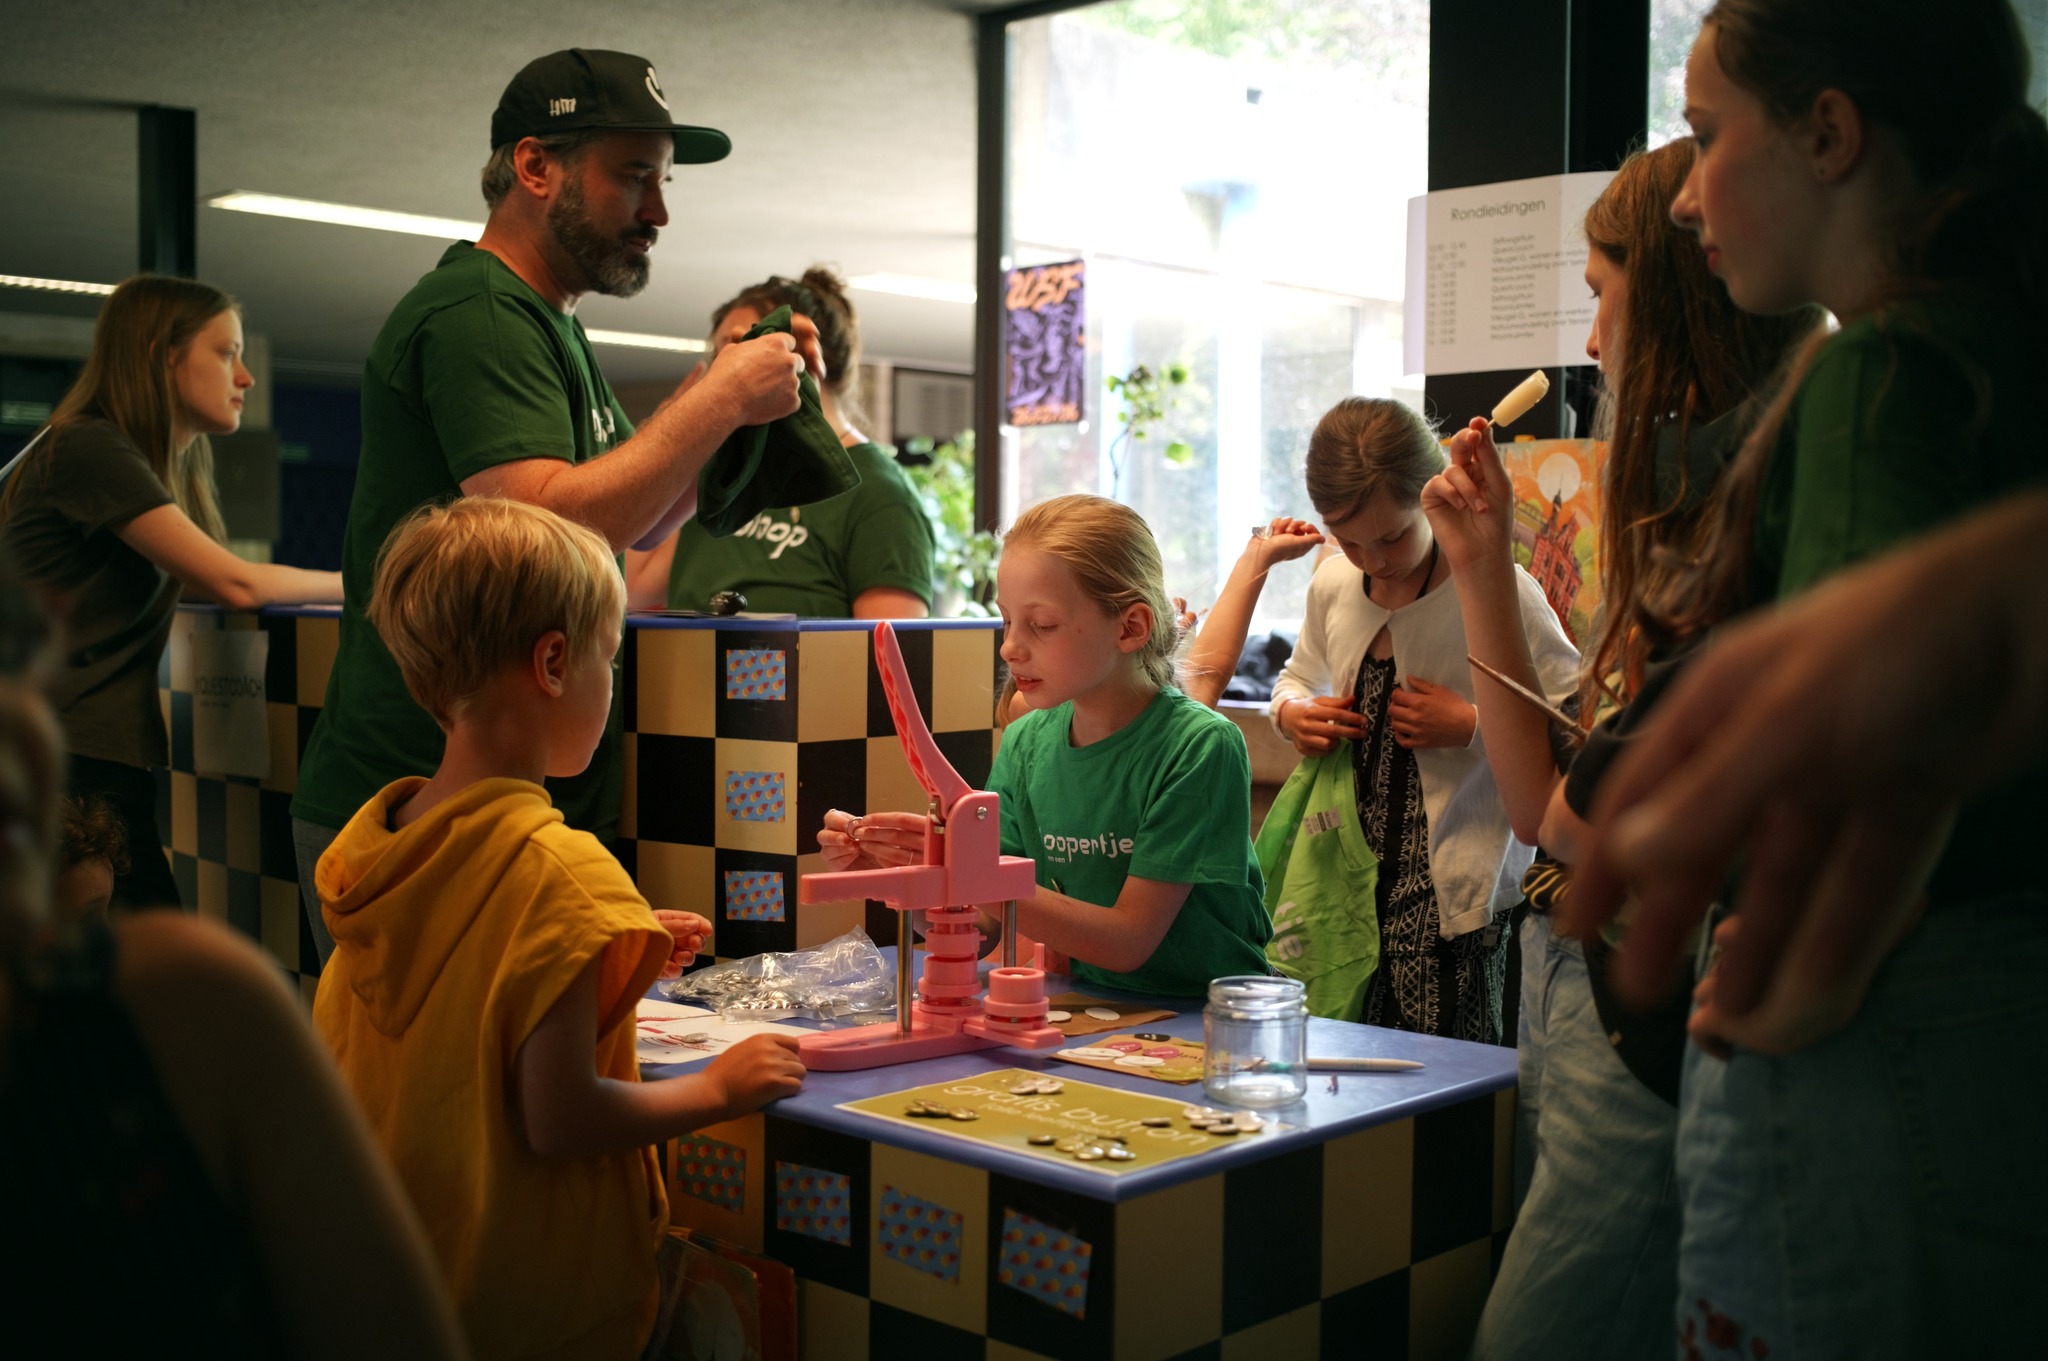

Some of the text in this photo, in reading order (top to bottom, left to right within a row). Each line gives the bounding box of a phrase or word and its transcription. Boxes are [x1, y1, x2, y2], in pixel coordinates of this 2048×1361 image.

[1451, 199, 1546, 221] Rondleidingen
[1039, 826, 1134, 863] oopertje
[943, 1085, 1061, 1111] gratis
